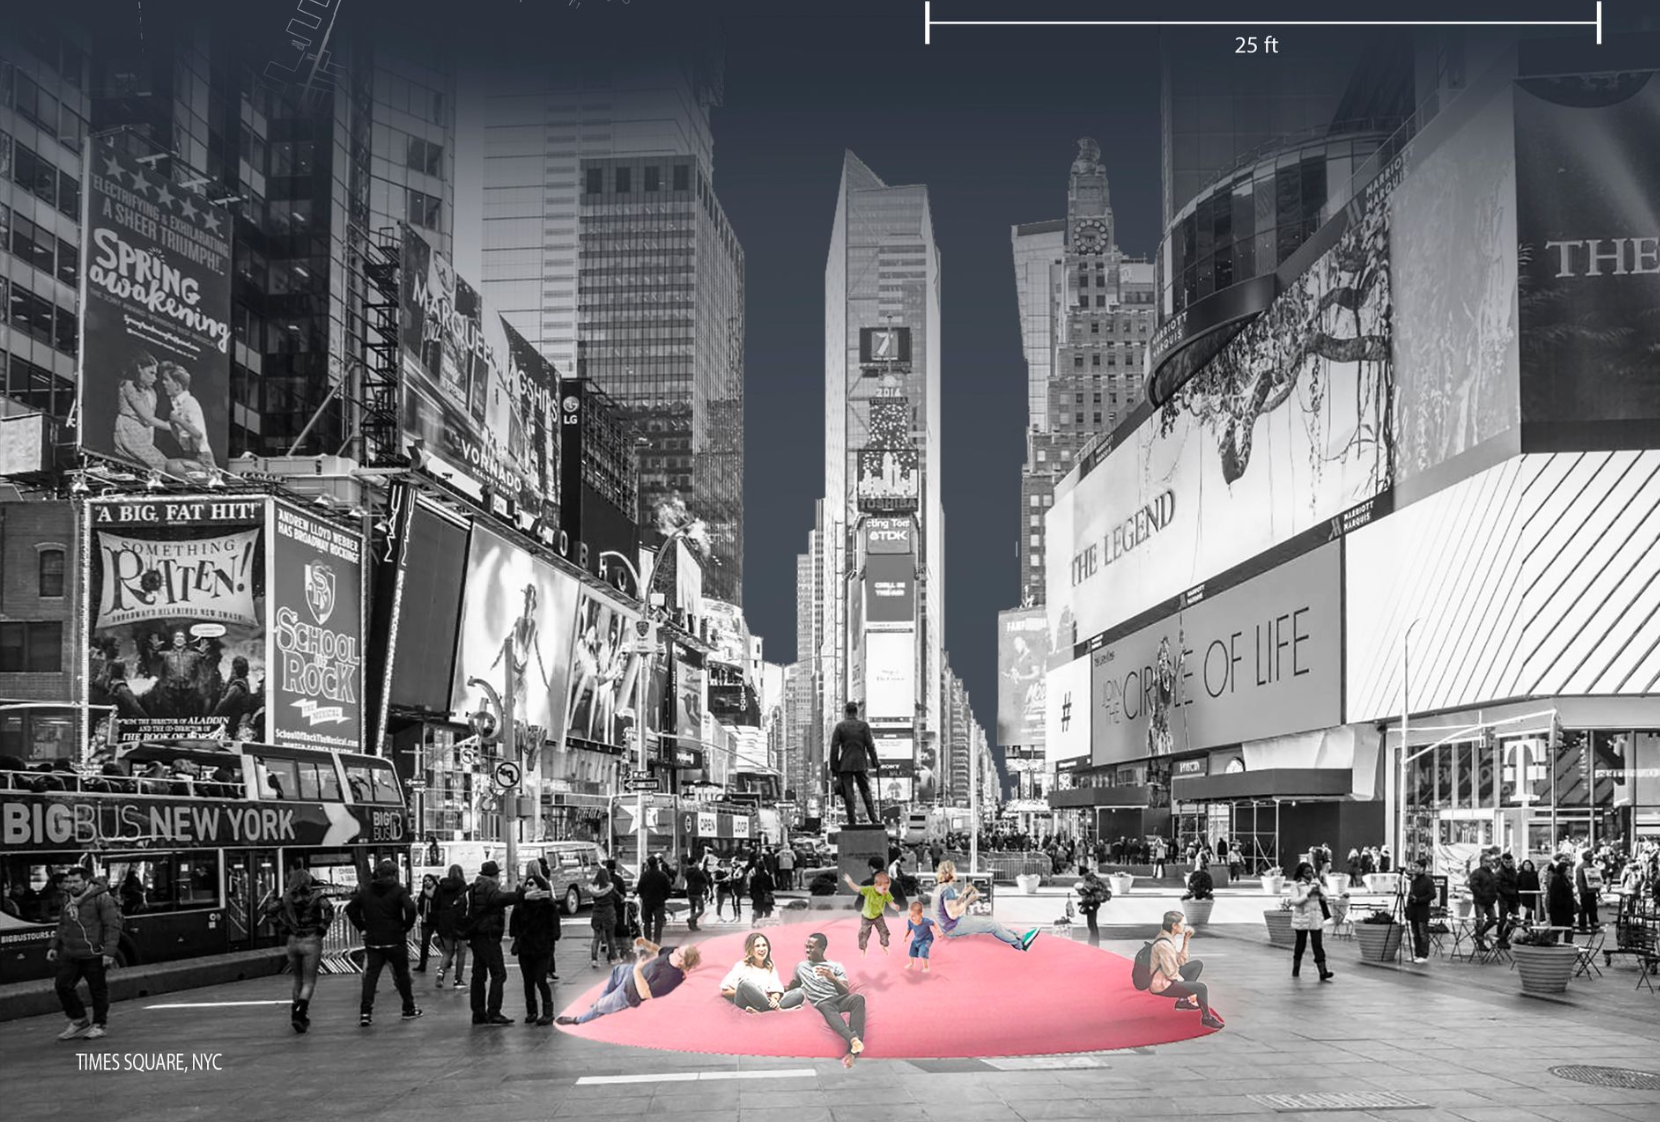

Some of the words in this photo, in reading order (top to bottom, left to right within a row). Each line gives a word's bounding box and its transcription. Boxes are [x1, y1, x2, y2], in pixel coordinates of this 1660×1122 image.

[1366, 143, 1415, 198] MARRIOTT
[93, 174, 160, 222] ELECTRIFYING
[103, 197, 113, 219] A
[115, 203, 157, 241] SHEER
[94, 228, 201, 305] SPRING
[1545, 237, 1660, 278] THE
[90, 264, 231, 353] awakening
[563, 414, 578, 425] LG
[461, 438, 522, 493] VORNADO
[166, 504, 205, 520] FAT
[860, 498, 918, 509] TOSHIBA
[121, 539, 236, 556] SOMETHING
[278, 520, 293, 538] HAS
[881, 531, 909, 541] TDK
[1072, 543, 1098, 588] THE
[1103, 488, 1176, 566] LEGEND
[103, 541, 253, 616] ROTTEN!
[276, 606, 360, 666] SCHOOL
[282, 649, 356, 704] ROCK
[1123, 649, 1194, 720] CIRLE
[1204, 632, 1243, 698] OF
[1256, 606, 1311, 686] LIFE
[122, 733, 141, 741] THE
[142, 733, 170, 741] BOOK
[188, 716, 230, 725] ALADDIN
[150, 806, 219, 842] NEW
[227, 809, 296, 841] YORK
[373, 811, 390, 827] BIG
[374, 826, 391, 841] BUS
[1, 930, 57, 944] BIGBUSTOURS.C
